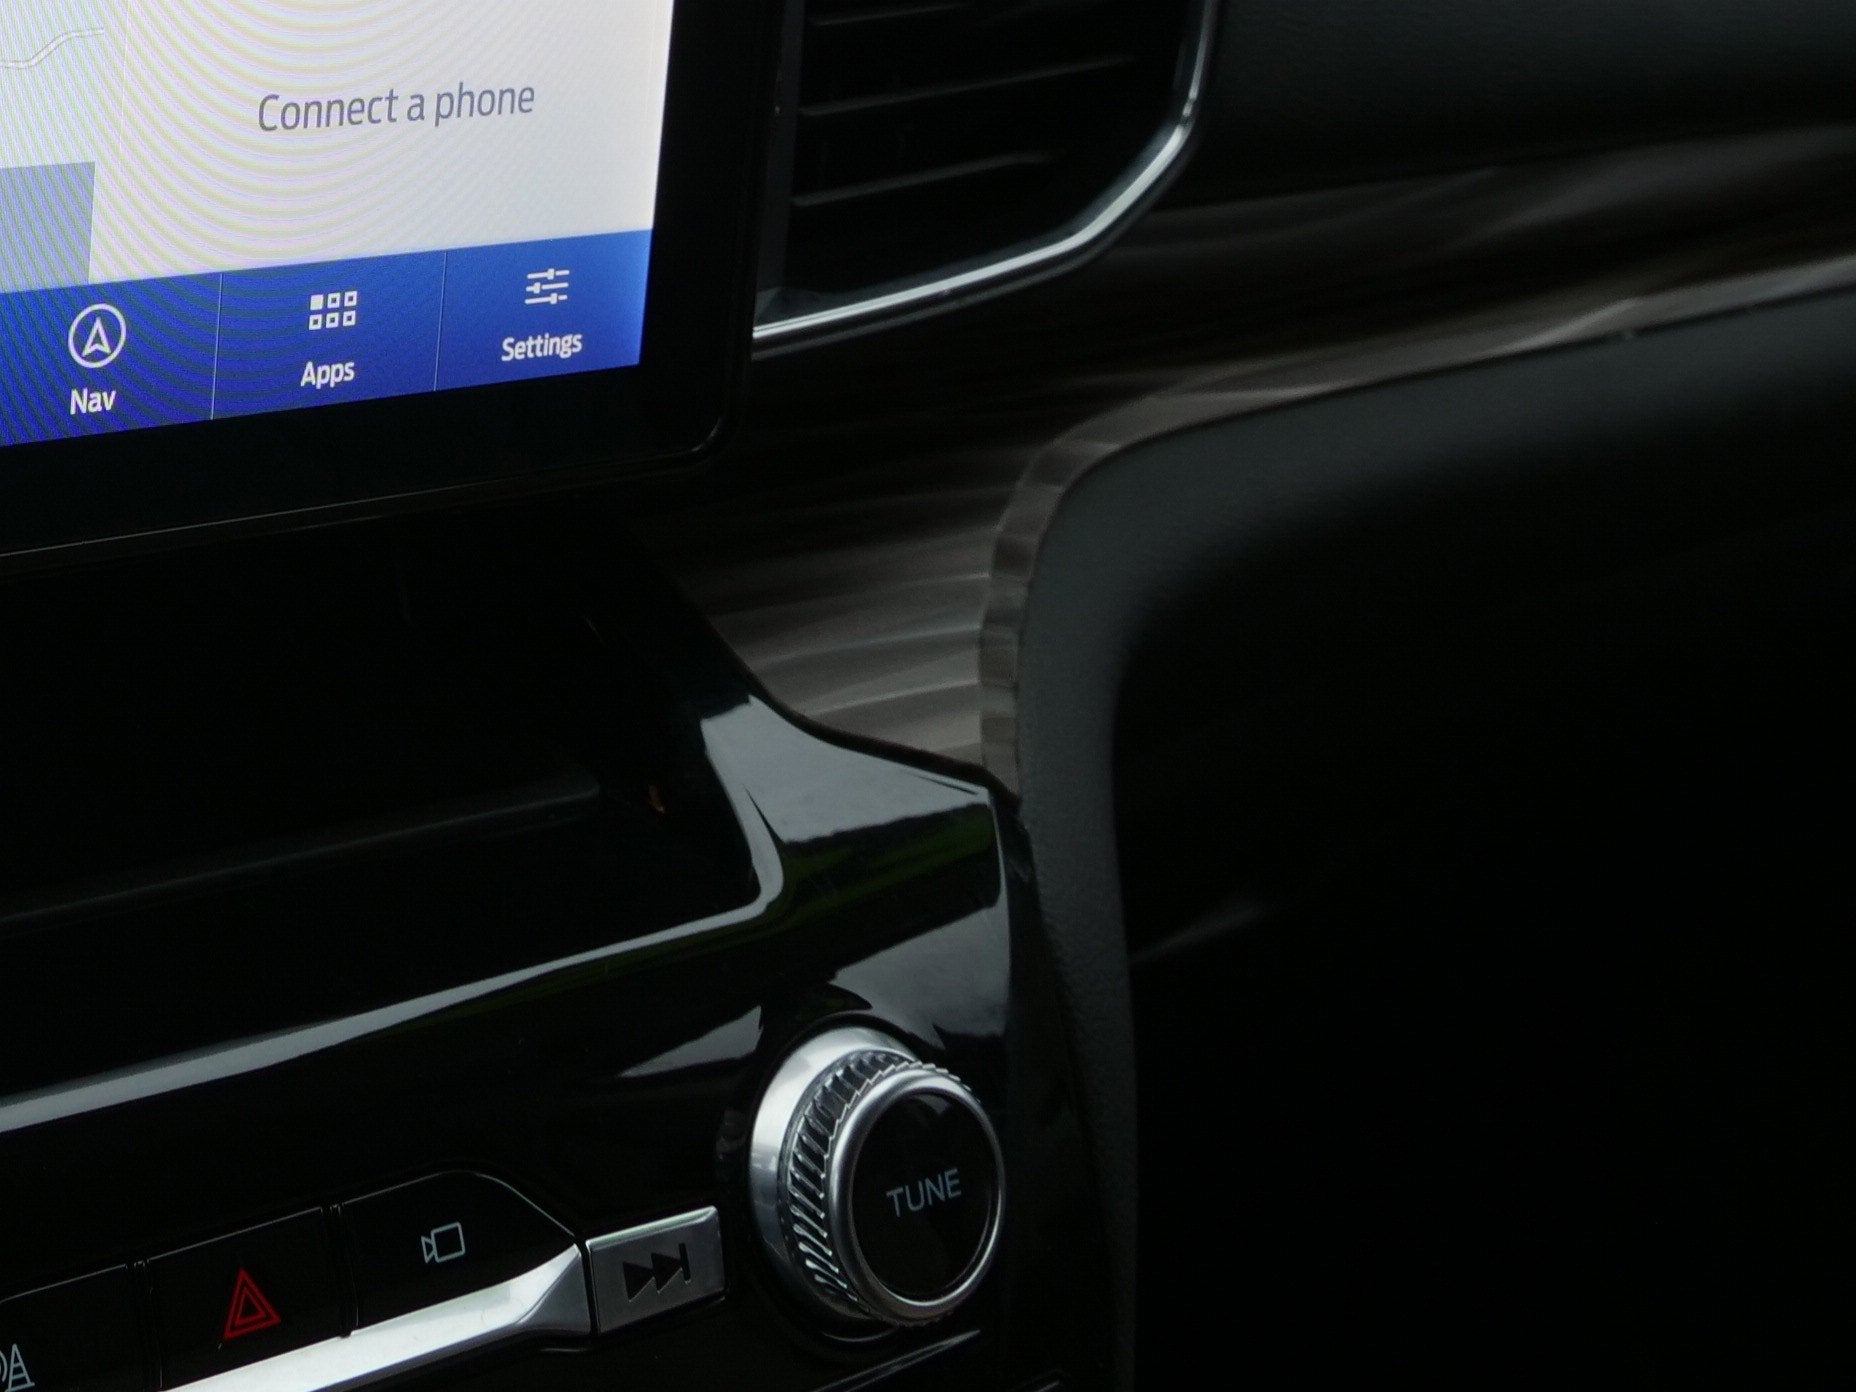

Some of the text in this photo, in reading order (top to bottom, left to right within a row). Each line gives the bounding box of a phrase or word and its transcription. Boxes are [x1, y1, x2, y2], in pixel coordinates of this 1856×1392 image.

[258, 82, 535, 132] Connect a phone
[501, 328, 582, 363] Settings
[300, 359, 355, 389] Apps
[69, 387, 116, 416] Nav
[887, 1168, 962, 1217] TUNE
